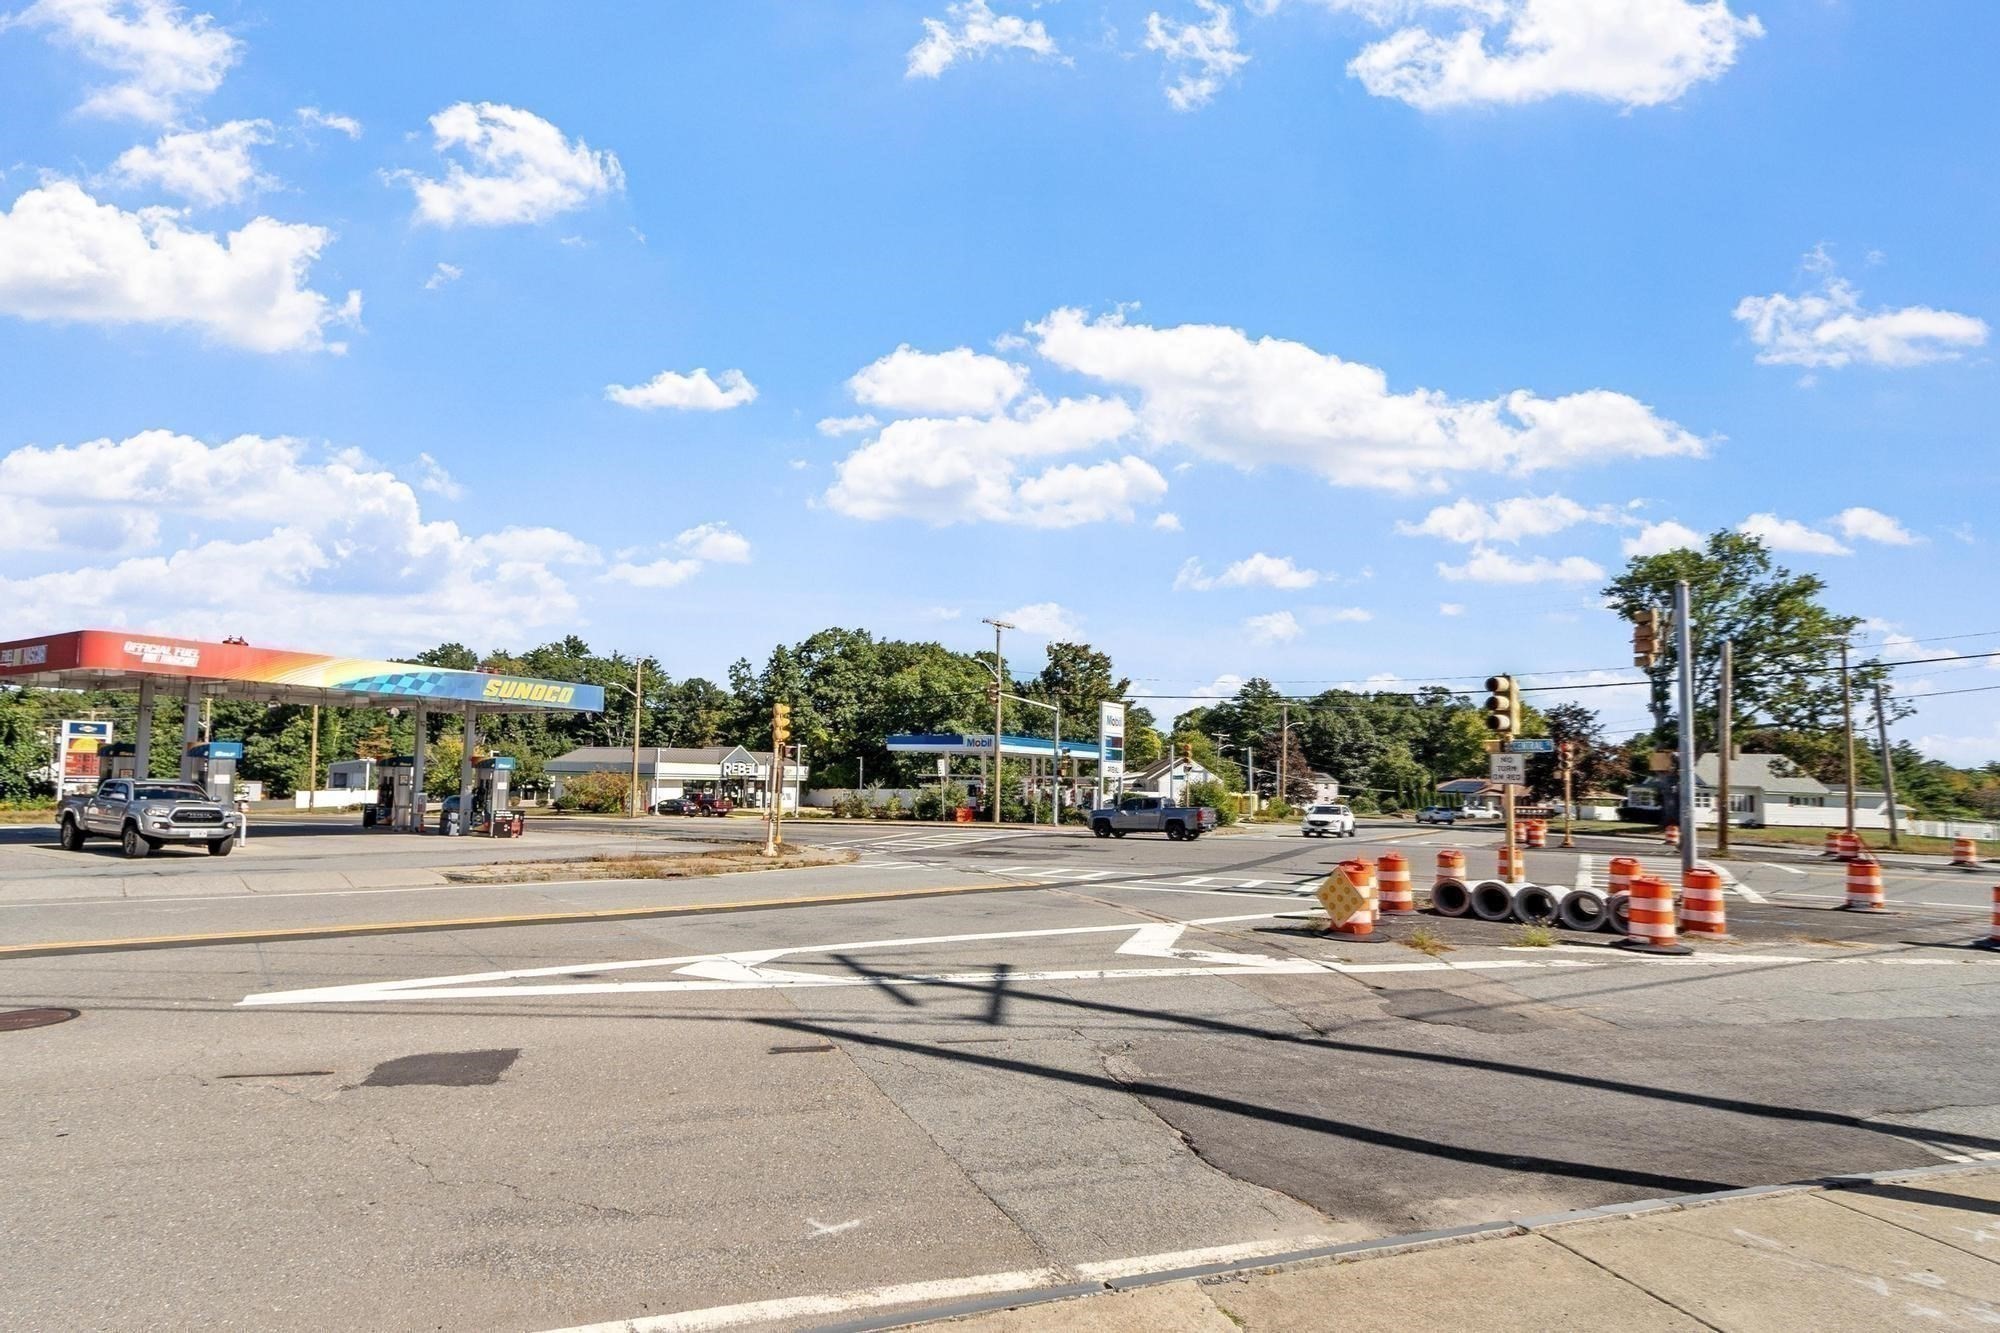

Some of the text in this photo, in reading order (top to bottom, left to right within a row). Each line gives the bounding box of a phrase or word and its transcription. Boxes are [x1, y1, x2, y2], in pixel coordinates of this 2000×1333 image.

[123, 641, 200, 658] OFFICIAL FUEL
[483, 679, 575, 703] SUNOCO
[1106, 714, 1123, 727] Mobil
[966, 737, 992, 748] Mobil
[1500, 756, 1513, 764] NO
[723, 762, 757, 777] REBEL
